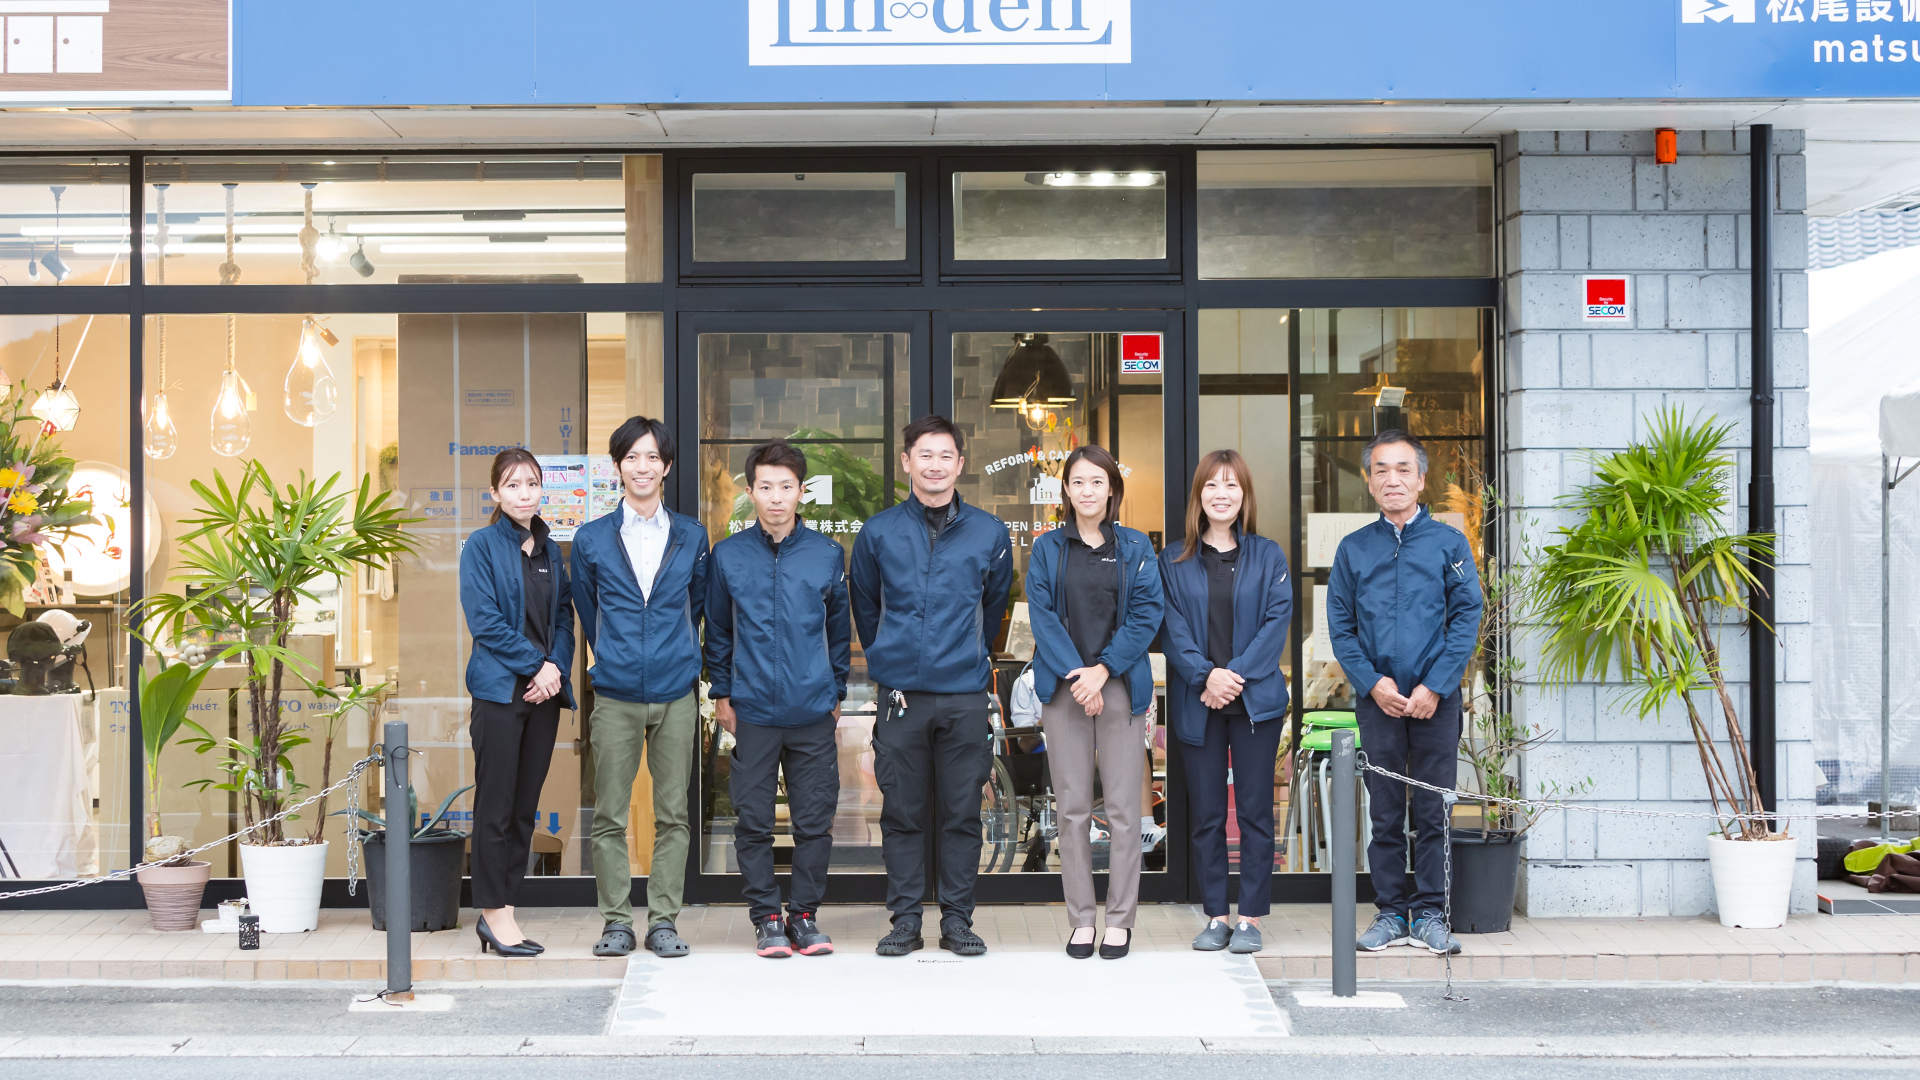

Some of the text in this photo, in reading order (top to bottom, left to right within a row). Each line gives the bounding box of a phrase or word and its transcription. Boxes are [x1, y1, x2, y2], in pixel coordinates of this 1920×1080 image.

[1588, 306, 1624, 315] SECOM
[1124, 361, 1159, 370] SECOM
[984, 452, 1034, 476] REFORM
[543, 471, 568, 483] PEN
[1004, 521, 1029, 532] PEN
